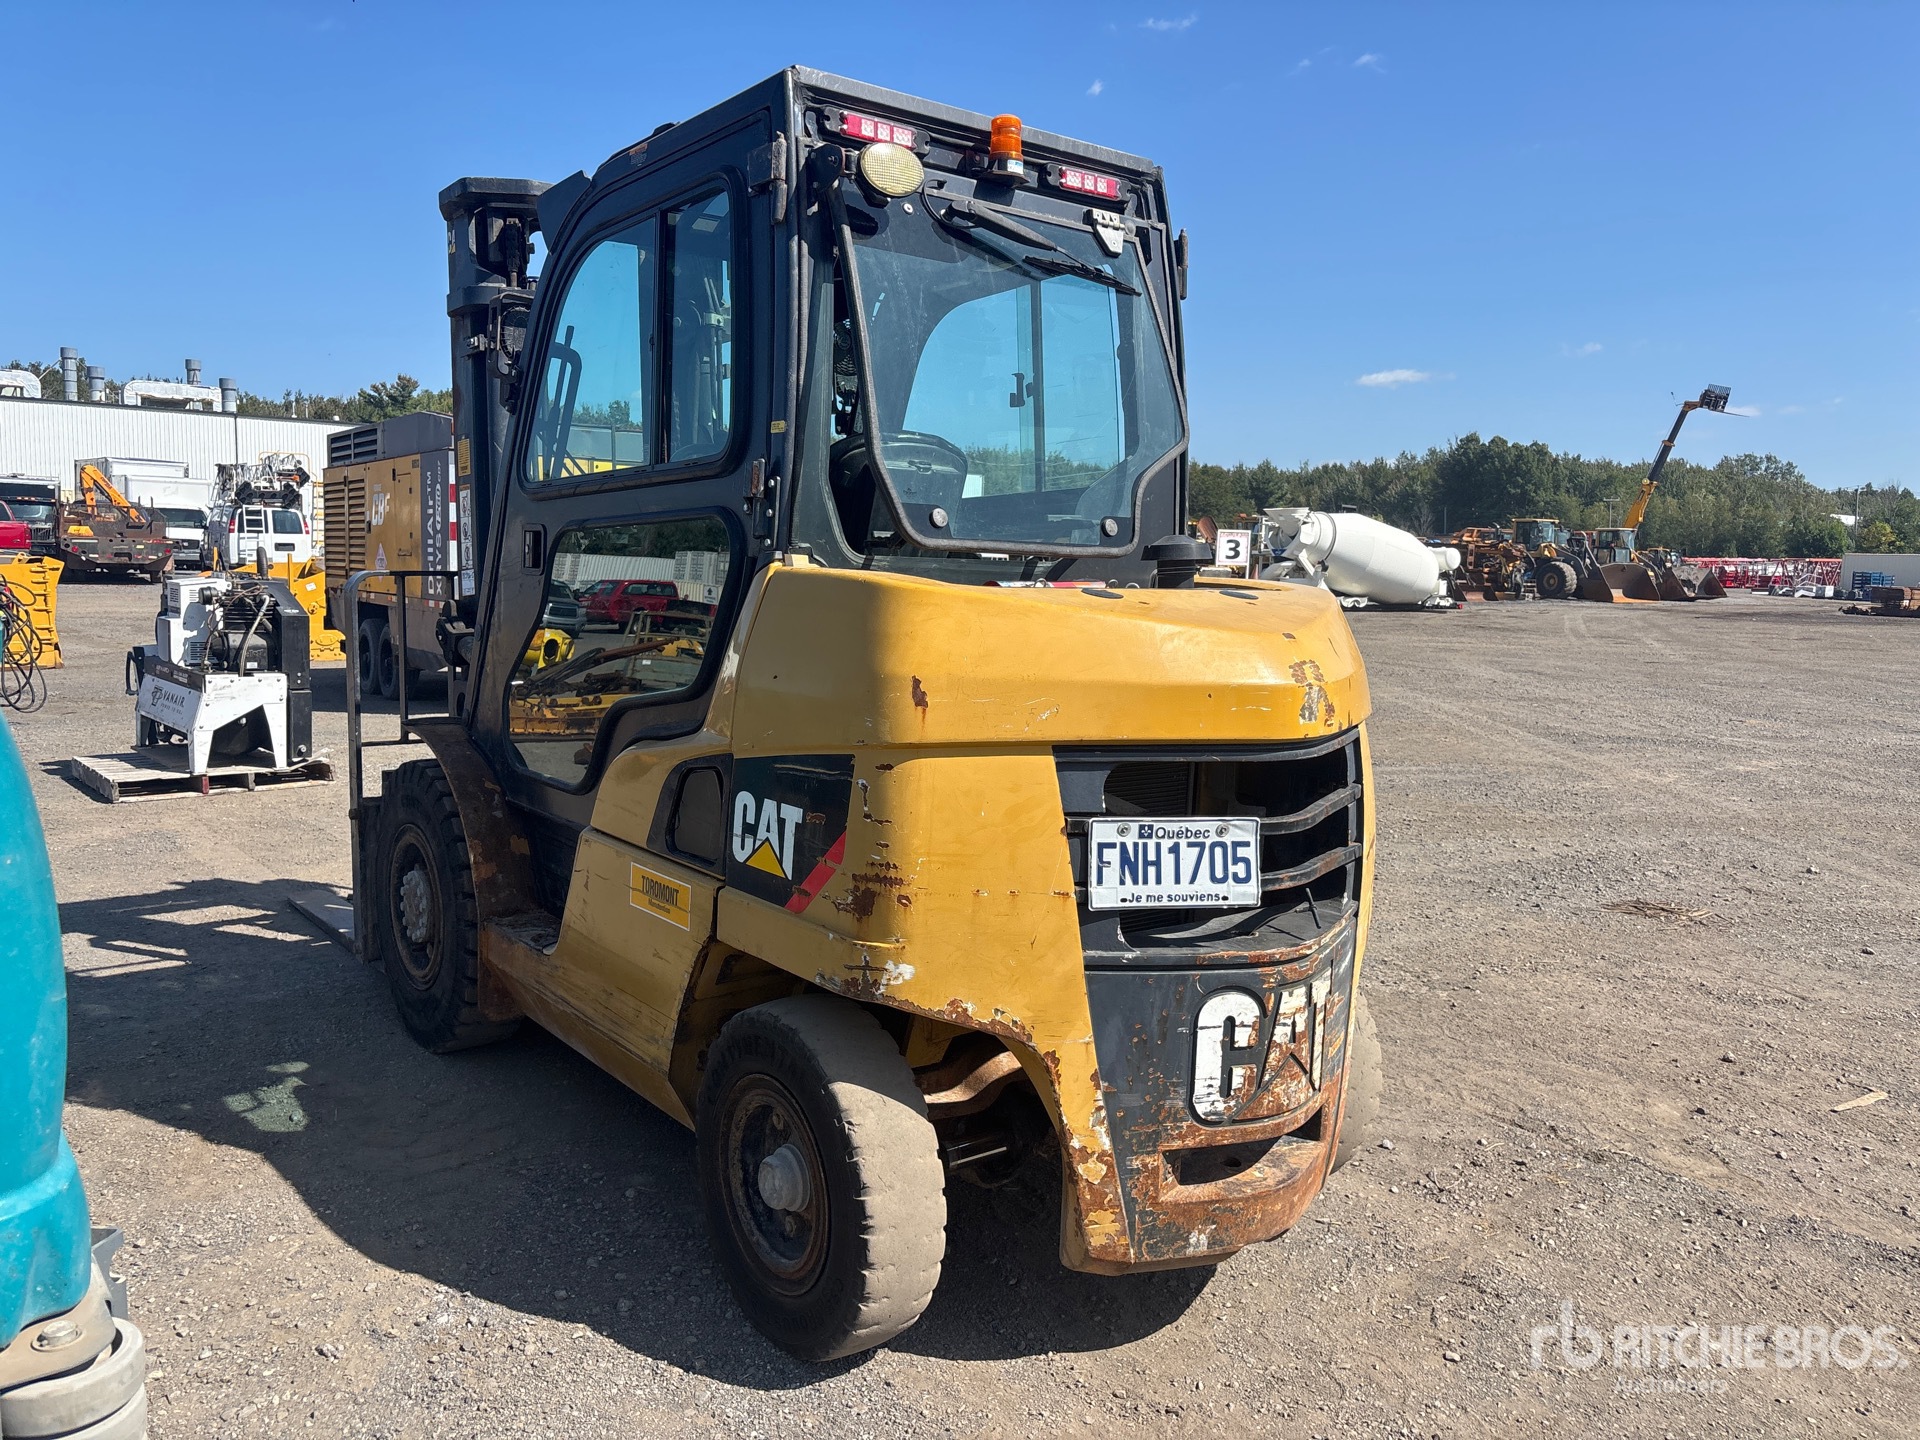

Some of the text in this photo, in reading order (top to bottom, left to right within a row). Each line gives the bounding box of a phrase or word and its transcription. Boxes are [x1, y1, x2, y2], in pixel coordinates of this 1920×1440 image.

[1225, 538, 1241, 560] 3
[163, 690, 186, 708] VANAIR
[732, 790, 803, 880] CAT
[1155, 826, 1211, 839] Québec
[1096, 840, 1252, 887] FNH1705
[641, 874, 680, 907] TOROMONT
[1129, 890, 1221, 903] Je me souviens
[1192, 967, 1332, 1122] CAT
